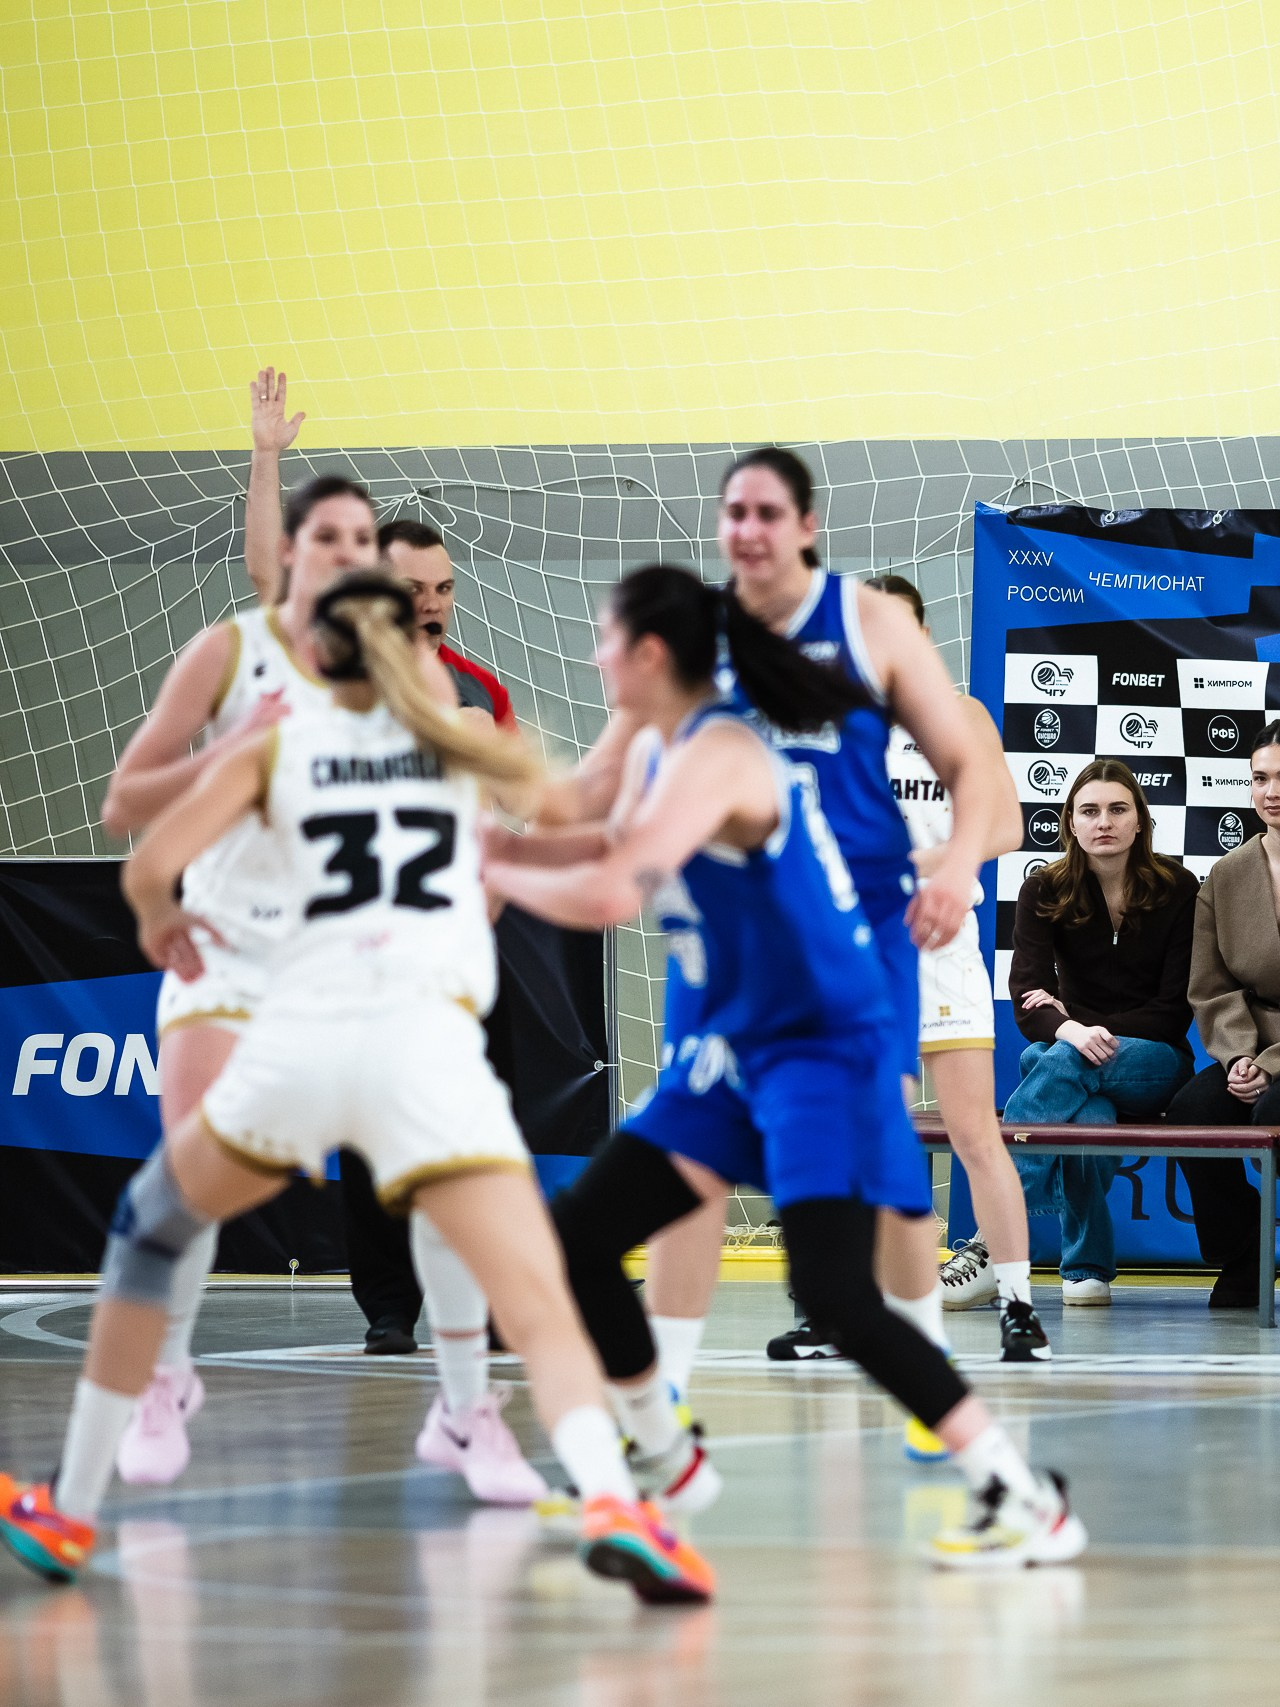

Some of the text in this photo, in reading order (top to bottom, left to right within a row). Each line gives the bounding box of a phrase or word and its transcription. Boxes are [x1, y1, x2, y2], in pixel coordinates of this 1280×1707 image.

[1008, 549, 1054, 567] XXXV
[1088, 571, 1205, 592] ЧЕМПИОНАТ
[1007, 585, 1084, 603] РОССИИ
[1111, 672, 1166, 688] FONBET
[1207, 679, 1253, 688] ХИМПРОМ
[1045, 688, 1066, 697] ЧГУ
[1211, 728, 1236, 739] РФБ
[1133, 741, 1153, 749] ЧГУ
[1132, 772, 1173, 787] NBET
[1214, 778, 1253, 787] ХИМПРО
[888, 778, 946, 801] АНТА
[1041, 788, 1061, 796] ЧГУ
[1033, 821, 1059, 833] РФБ
[302, 807, 457, 922] 32
[12, 1032, 165, 1097] FON
